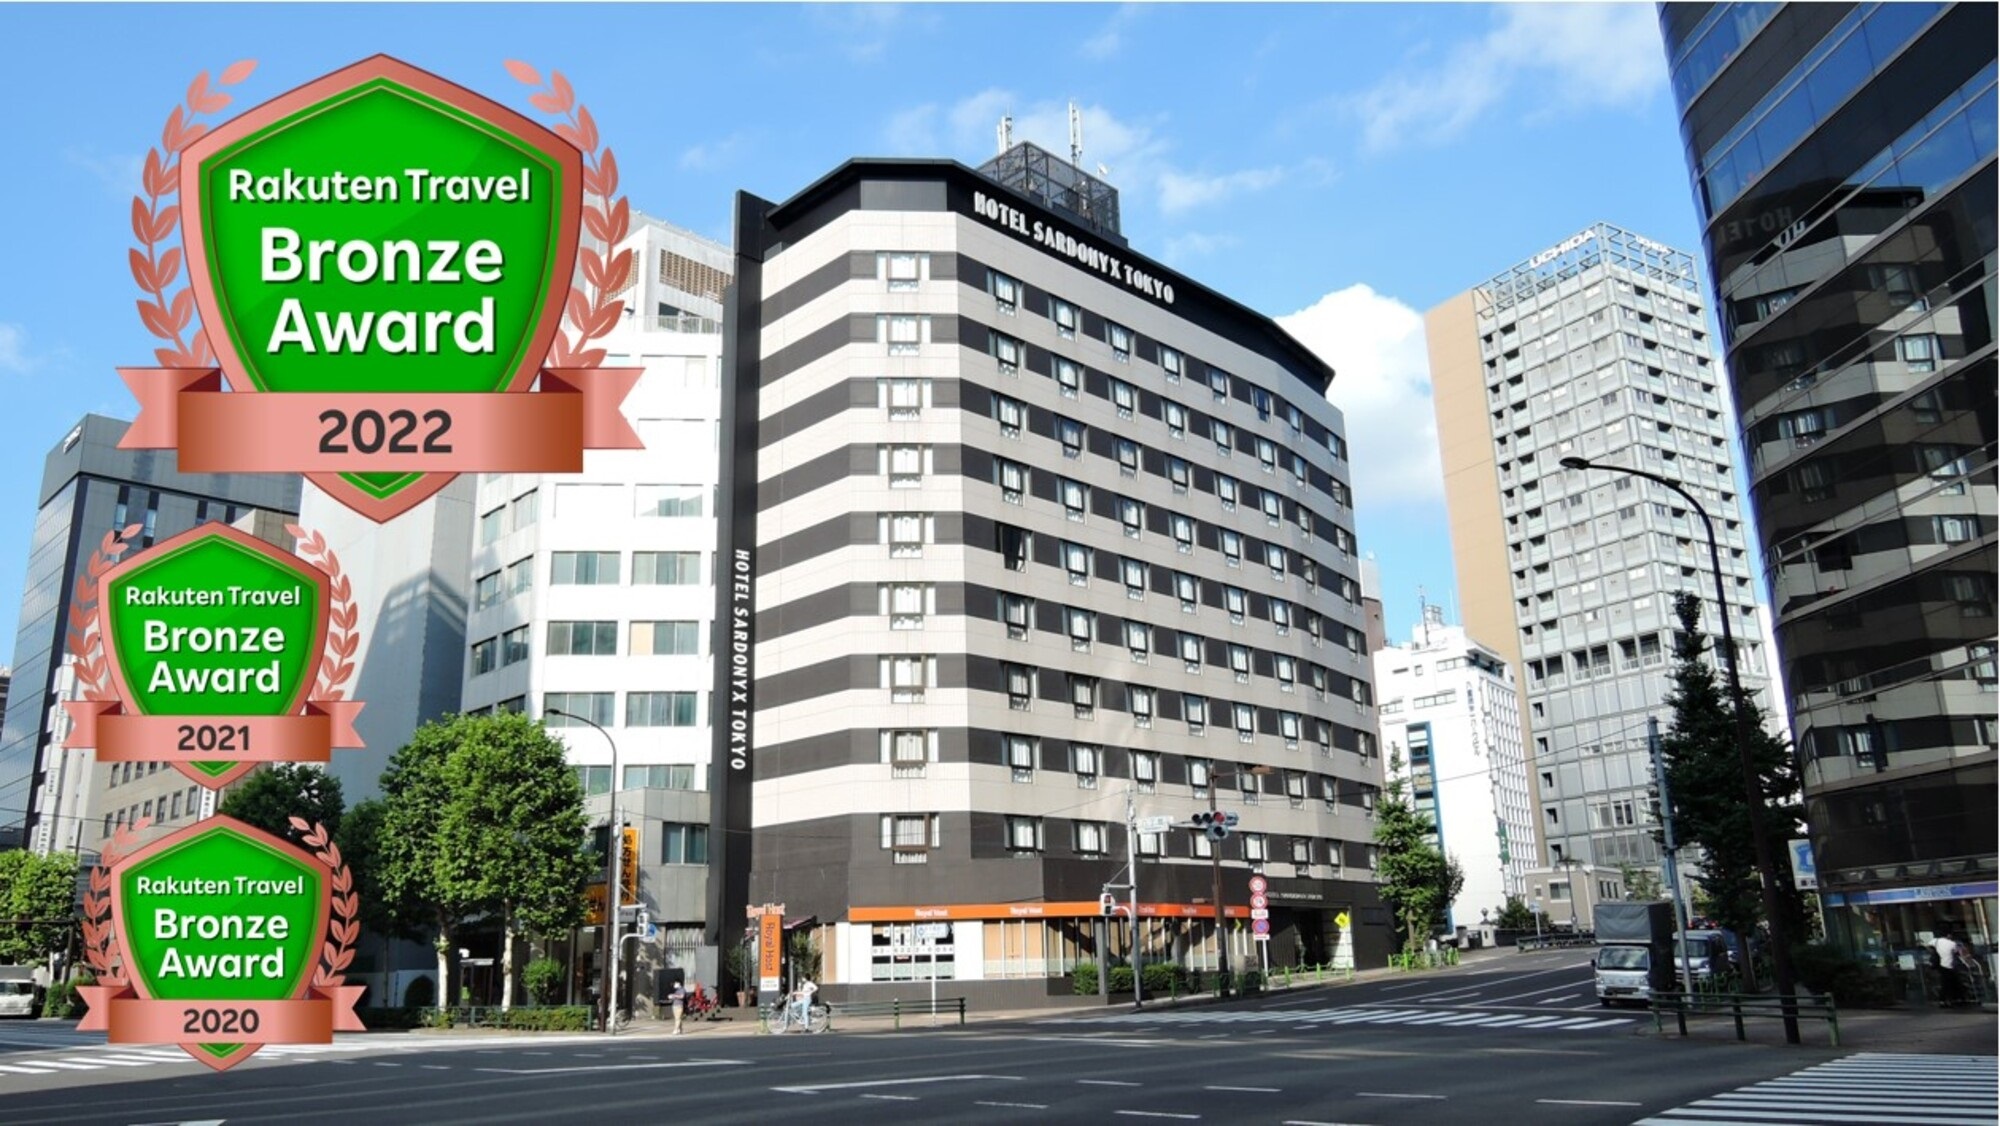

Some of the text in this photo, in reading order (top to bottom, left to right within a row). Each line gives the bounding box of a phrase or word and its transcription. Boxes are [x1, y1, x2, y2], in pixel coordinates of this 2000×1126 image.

[974, 191, 1175, 304] HOTEL SARDONYX TOKYO
[1529, 230, 1596, 268] UCHIDA
[730, 549, 750, 770] HOTEL SARDONYX TOKYO
[764, 922, 774, 948] Royal
[765, 950, 774, 971] Host
